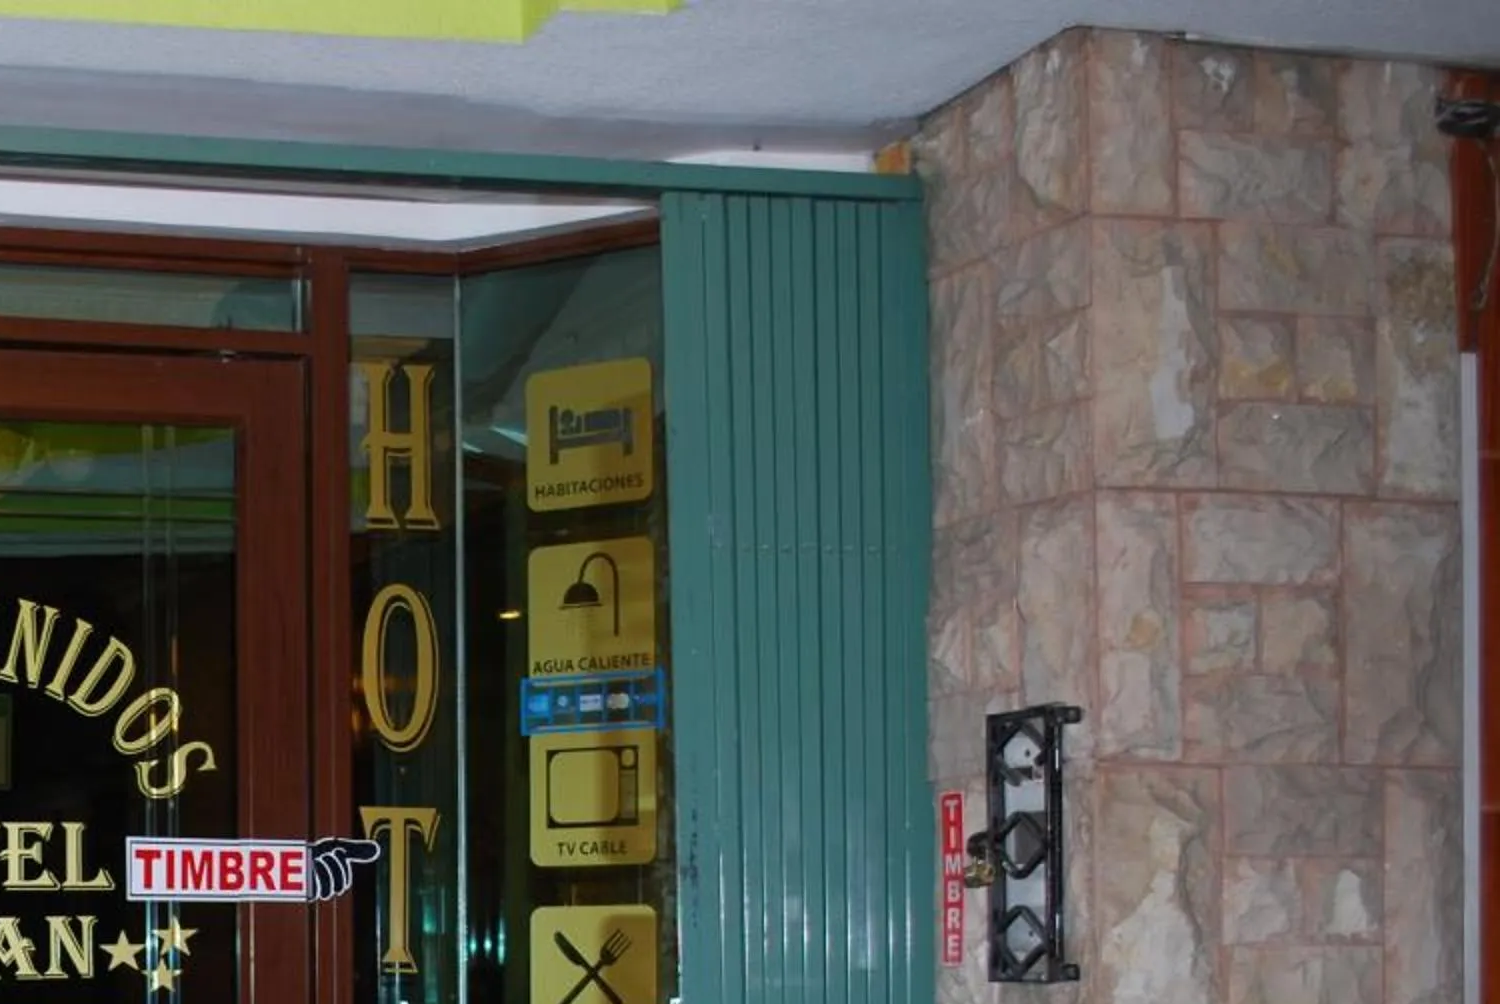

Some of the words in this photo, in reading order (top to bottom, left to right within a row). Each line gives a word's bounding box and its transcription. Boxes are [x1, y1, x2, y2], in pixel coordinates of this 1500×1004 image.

[534, 472, 644, 498] HABITACIONES
[532, 658, 574, 675] AGUA
[577, 652, 651, 672] CALIENTE
[556, 841, 577, 857] TV
[579, 839, 629, 857] CABLE
[135, 848, 306, 892] TIMBRE
[944, 799, 962, 958] TIMBRE
